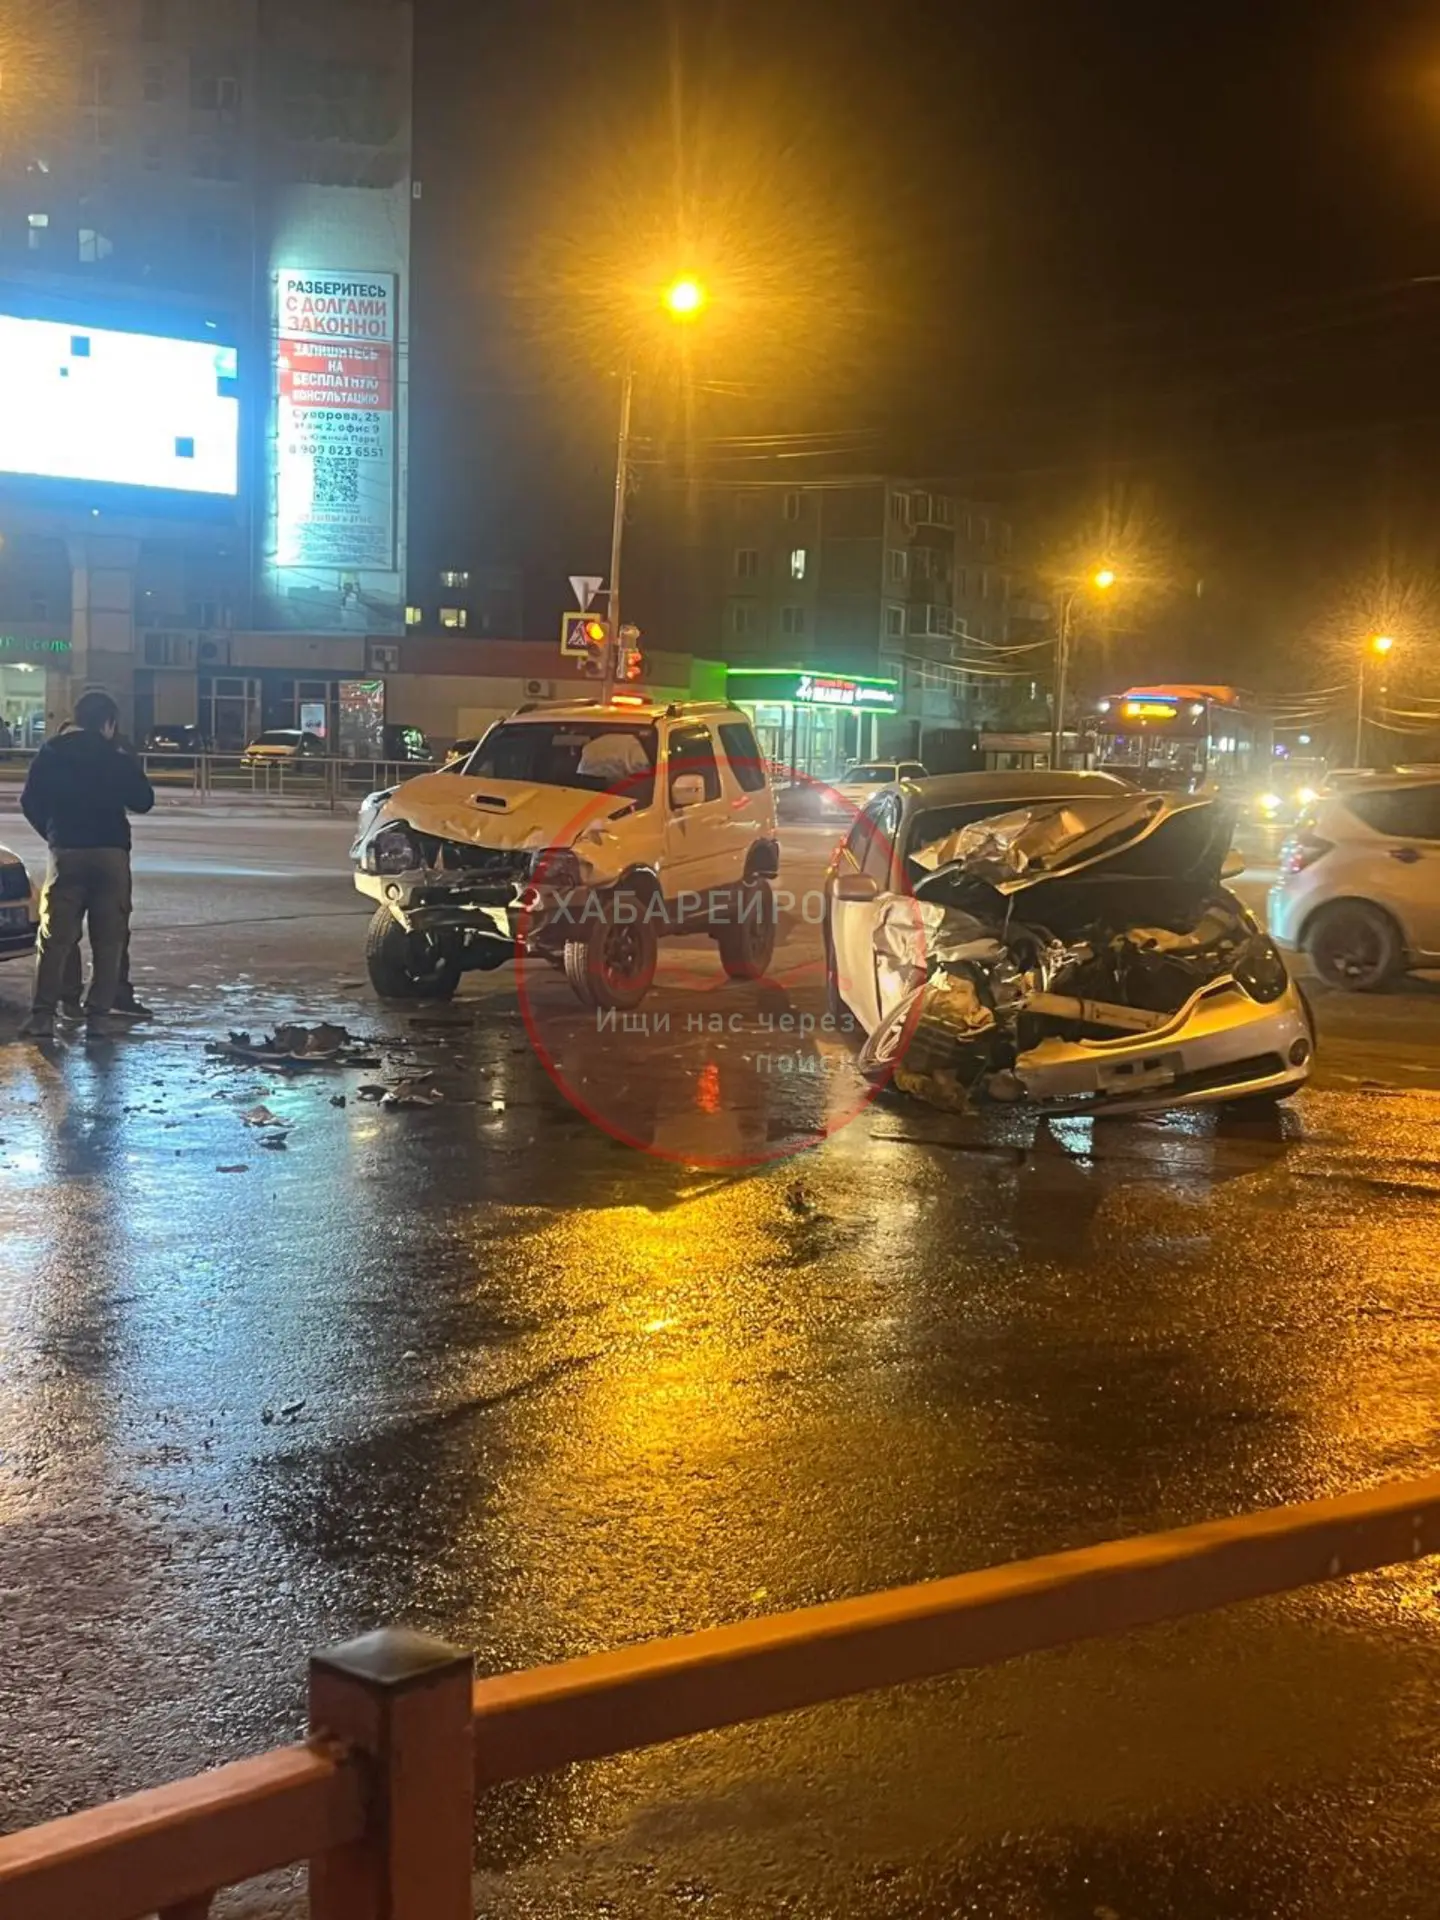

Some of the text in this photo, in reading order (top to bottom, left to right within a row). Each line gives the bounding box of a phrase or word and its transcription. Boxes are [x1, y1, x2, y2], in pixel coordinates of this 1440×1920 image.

[288, 280, 386, 297] РАЗБЕРИТЕСЬ
[286, 296, 387, 316] С ДОЛГАМИ
[328, 360, 343, 372] НА
[292, 372, 379, 389] БЕСПЛАТНУЮ
[291, 388, 380, 404] КОНСУЛЬТАЦИЮ
[292, 409, 381, 422] Суворова, 25
[338, 424, 370, 434] офис
[329, 445, 352, 456] 823
[355, 446, 384, 457] 6551
